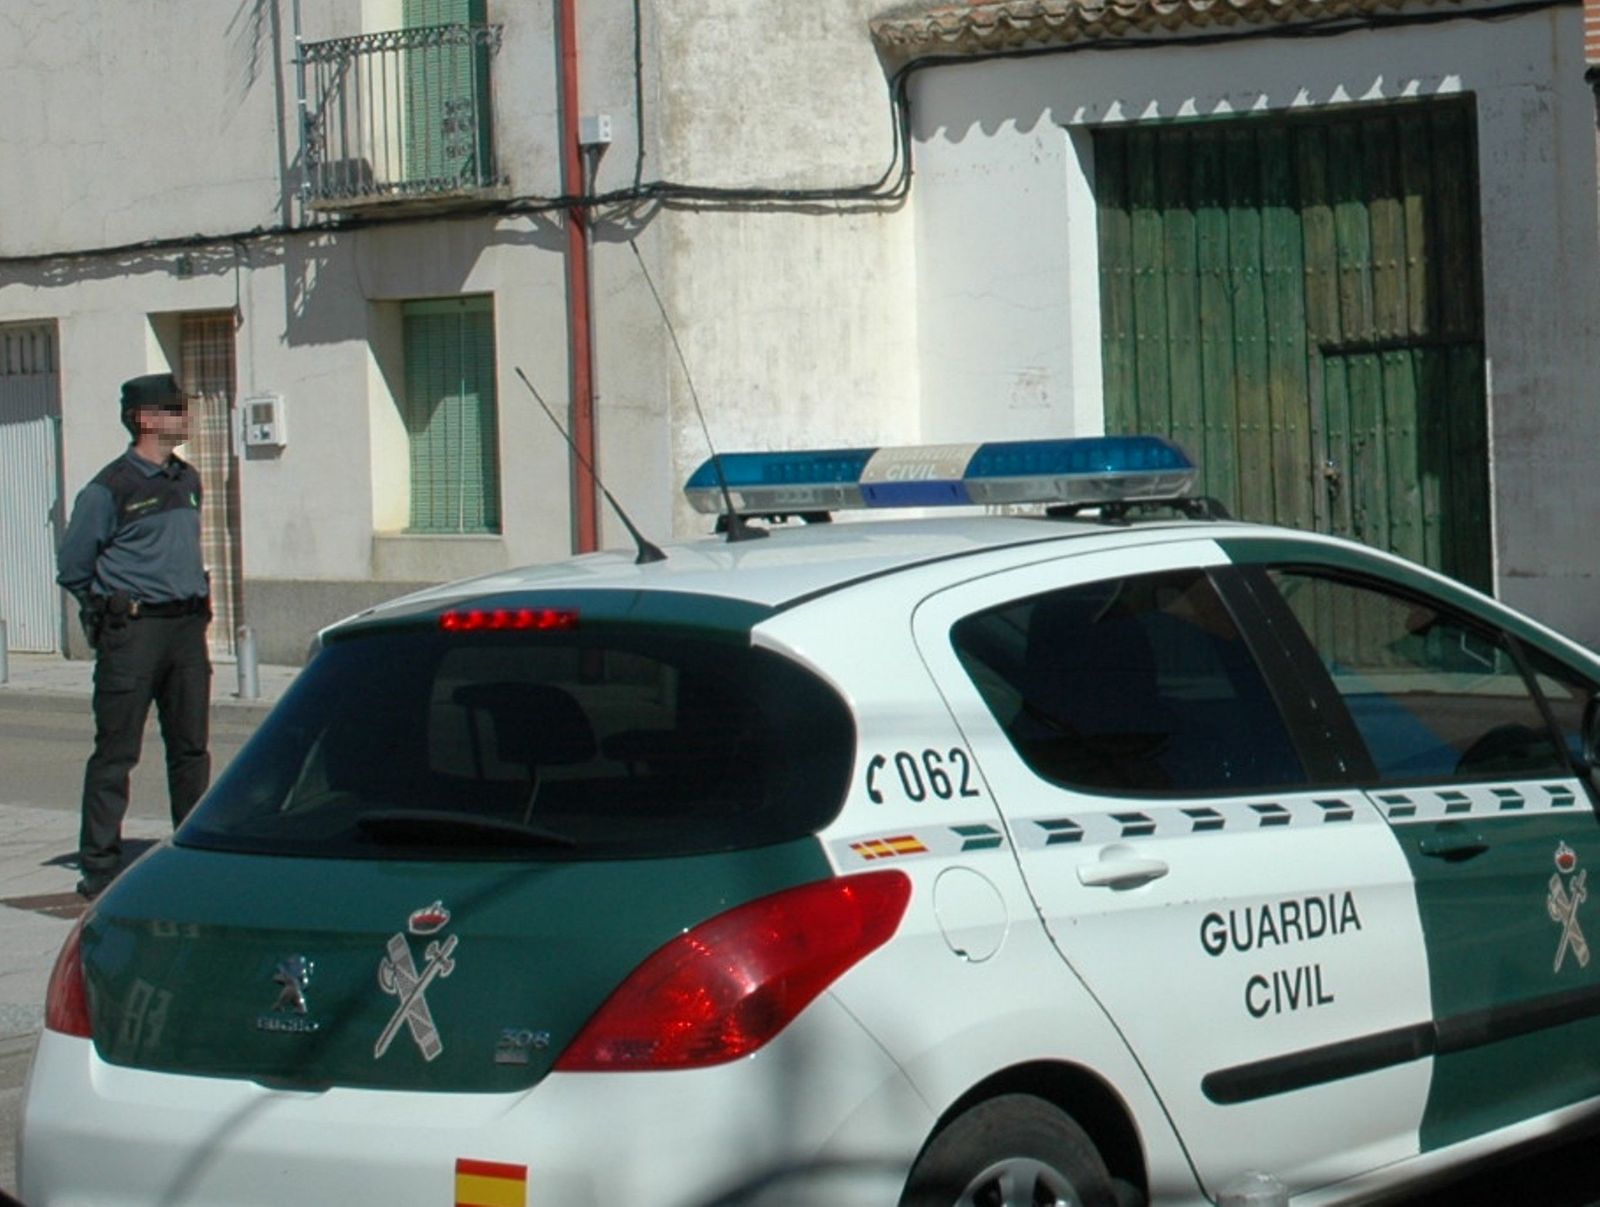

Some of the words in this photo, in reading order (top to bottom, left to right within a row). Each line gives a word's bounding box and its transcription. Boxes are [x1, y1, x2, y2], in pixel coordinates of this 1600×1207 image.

[886, 464, 937, 480] CIVIL
[894, 747, 980, 802] 062
[1200, 890, 1362, 957] GUARDIA
[1245, 964, 1335, 1018] CIVIL
